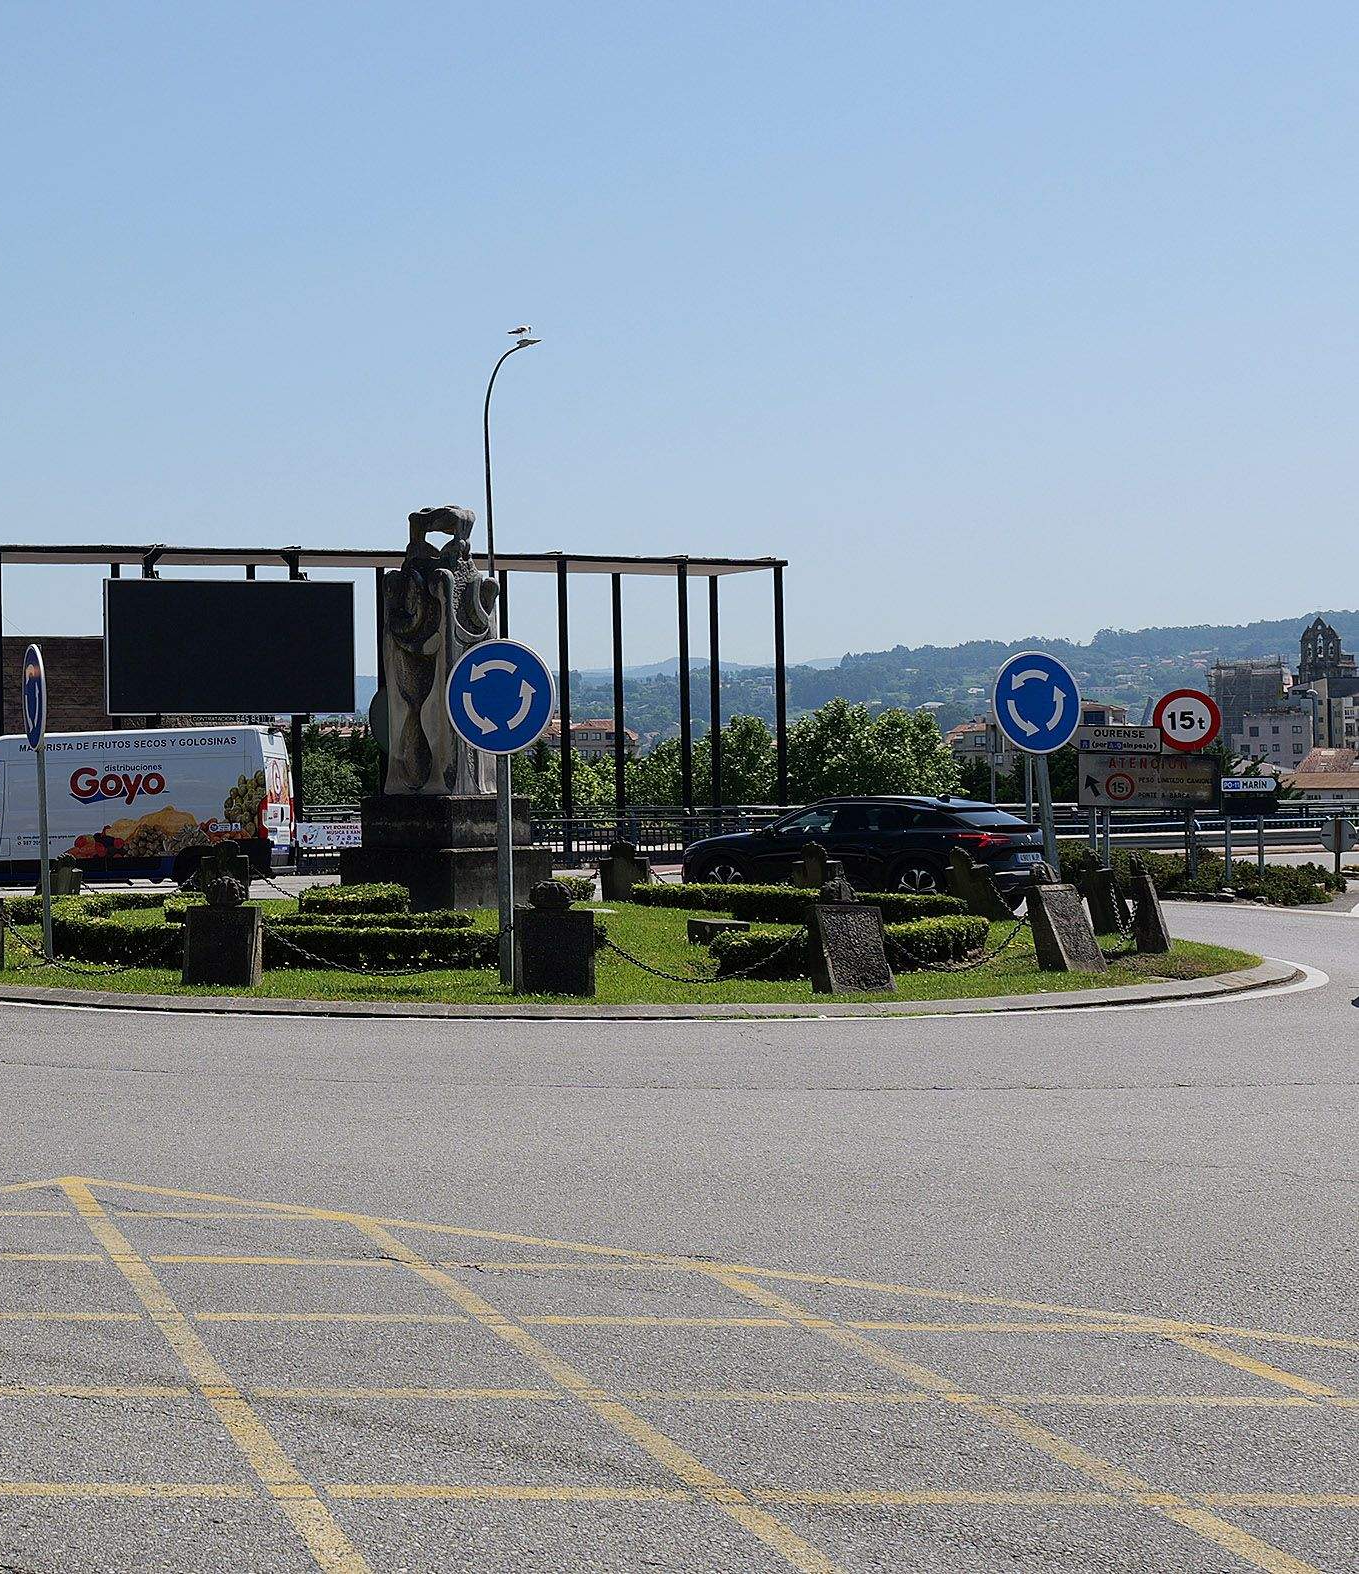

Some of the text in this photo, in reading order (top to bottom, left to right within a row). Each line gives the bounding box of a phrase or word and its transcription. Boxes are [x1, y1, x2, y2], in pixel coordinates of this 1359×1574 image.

[1167, 711, 1206, 731] 15 t
[1093, 729, 1146, 739] OURENSE
[19, 736, 237, 752] MARISTA DE FRUTOS SECOS Y GOLOSINAS
[1134, 742, 1157, 750] peaje)
[104, 764, 163, 772] distribuciones
[69, 767, 166, 806] Goyo
[1111, 782, 1125, 793] 15
[1242, 780, 1268, 789] MARÍN
